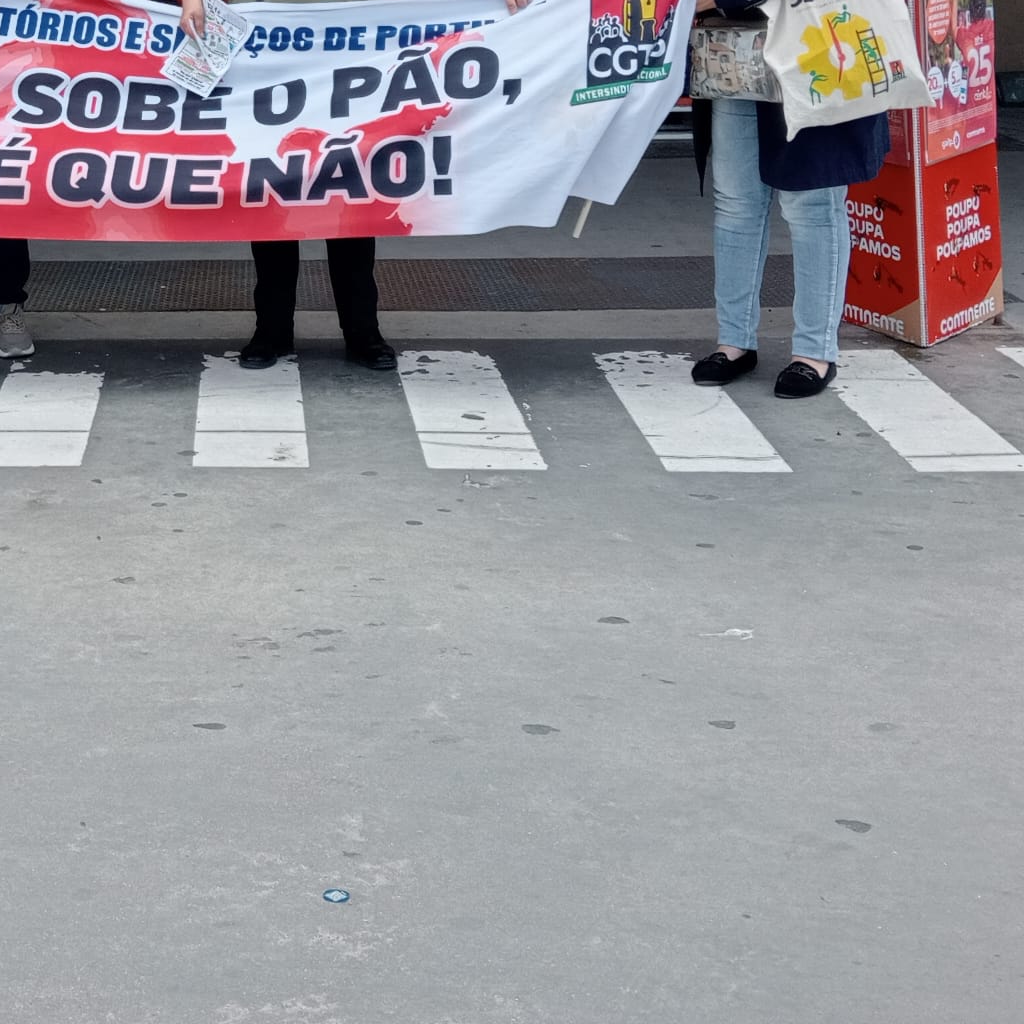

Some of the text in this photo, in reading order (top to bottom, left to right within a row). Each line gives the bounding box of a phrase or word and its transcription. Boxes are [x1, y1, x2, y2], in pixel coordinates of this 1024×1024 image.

[125, 22, 148, 51] E
[323, 26, 367, 52] DE
[967, 45, 992, 88] 25
[12, 71, 233, 133] SOBE
[253, 78, 307, 126] O
[330, 45, 522, 119] PÃO,
[52, 154, 224, 206] QUE
[246, 134, 453, 203] NÃO!
[845, 199, 884, 223] OUPO
[946, 195, 980, 223] POUPO
[848, 220, 885, 241] OUPA
[947, 213, 981, 239] POUPA
[936, 225, 992, 262] POUPAMOS
[844, 303, 905, 336] NTINENTE
[940, 296, 996, 335] CONTINENTE
